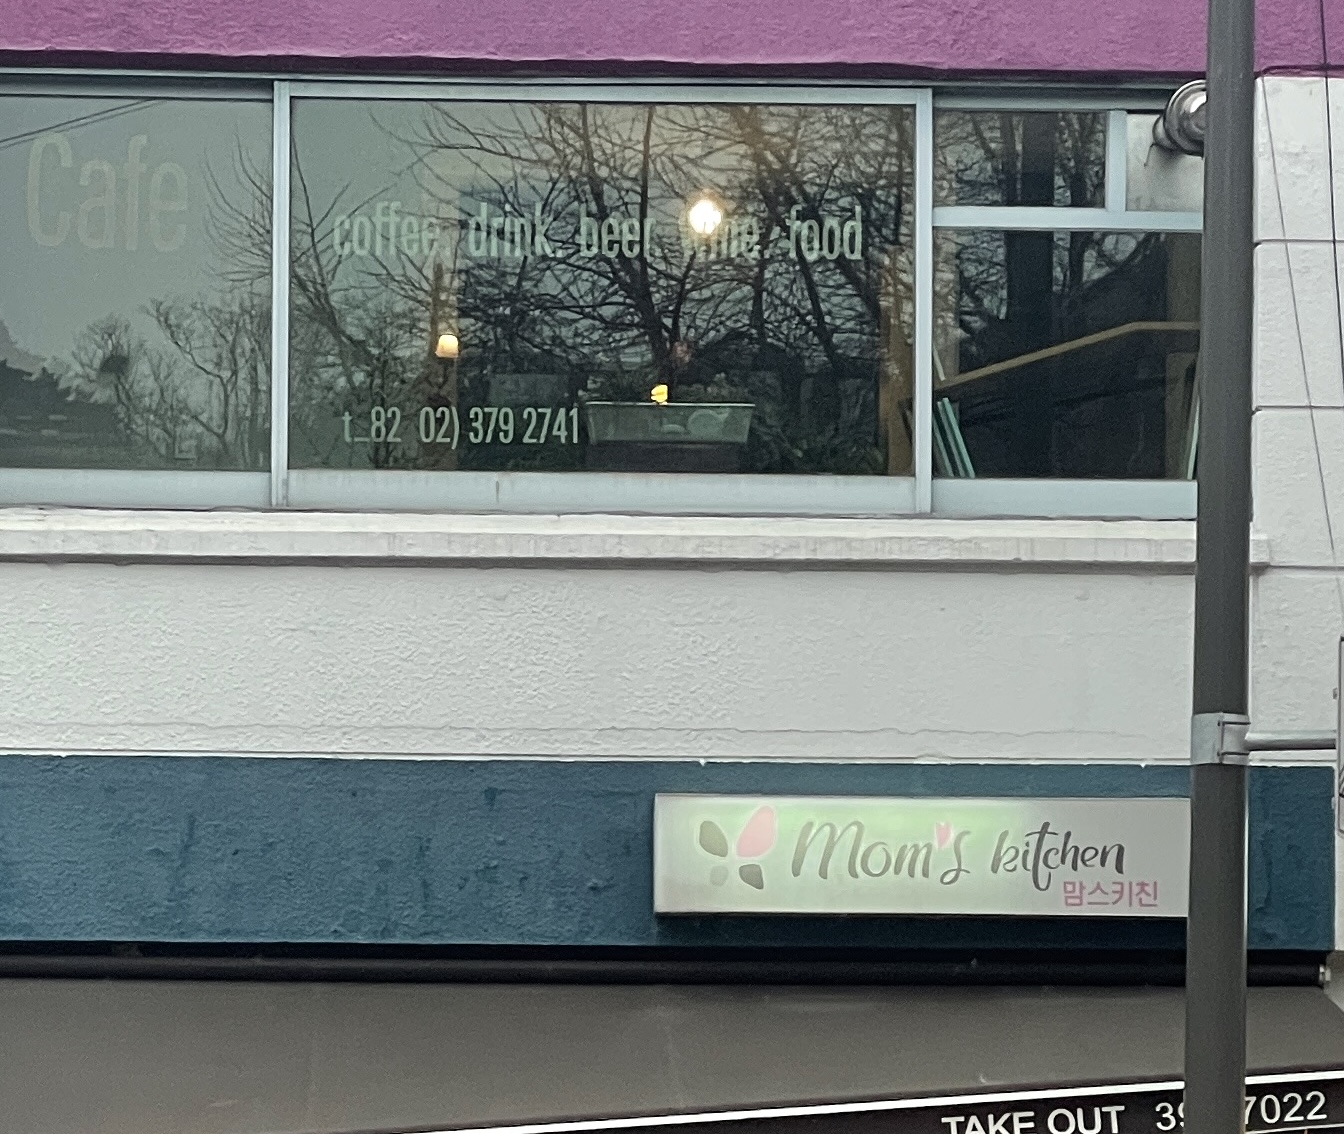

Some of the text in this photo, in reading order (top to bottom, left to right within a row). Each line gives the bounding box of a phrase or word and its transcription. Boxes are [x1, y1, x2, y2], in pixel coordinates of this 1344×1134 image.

[27, 132, 189, 252] Cafe
[785, 204, 862, 262] food
[419, 406, 460, 450] 02)
[469, 406, 515, 444] 379
[522, 406, 579, 444] 2741
[990, 821, 1125, 891] kitchen
[1063, 880, 1159, 909] 맘스키친
